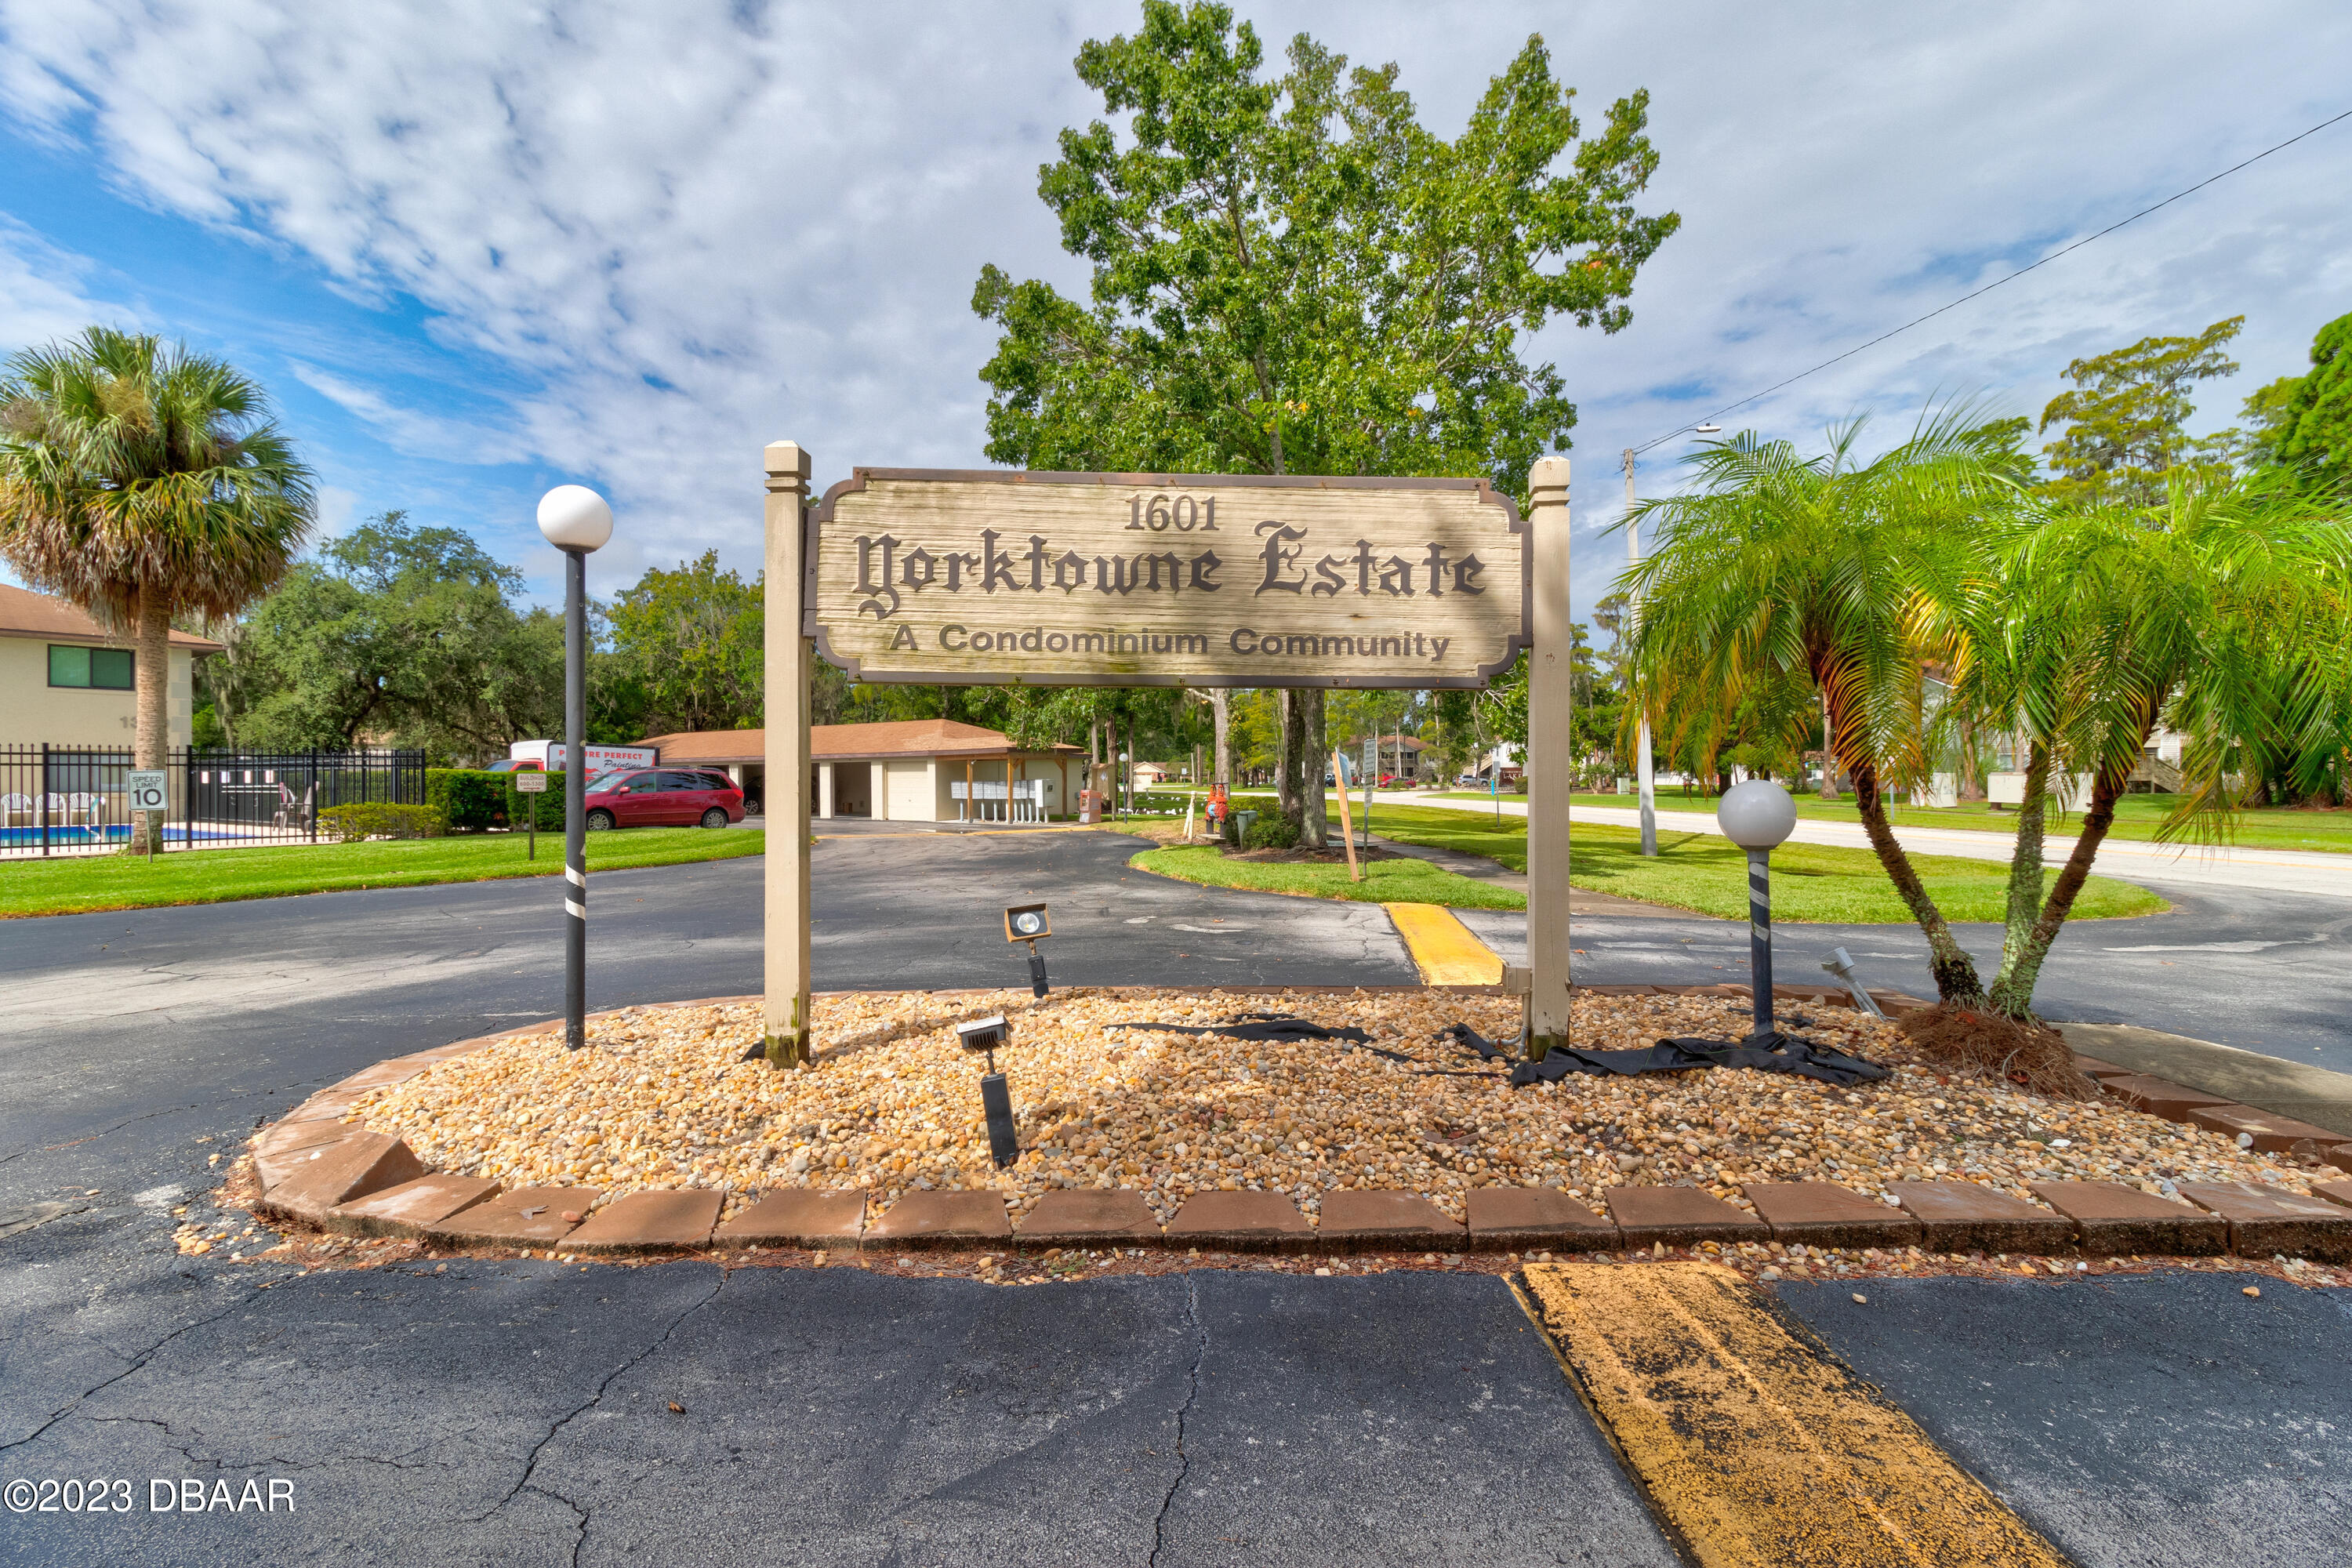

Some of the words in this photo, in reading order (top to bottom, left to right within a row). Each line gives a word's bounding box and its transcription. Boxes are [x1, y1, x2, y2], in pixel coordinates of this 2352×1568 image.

[1124, 494, 1219, 531] 1601
[852, 528, 1223, 621] Yorktowne
[1254, 520, 1486, 598] Estate
[889, 623, 918, 651] A
[938, 624, 1207, 653] Condominium
[1229, 627, 1450, 662] Community
[132, 789, 162, 806] 10
